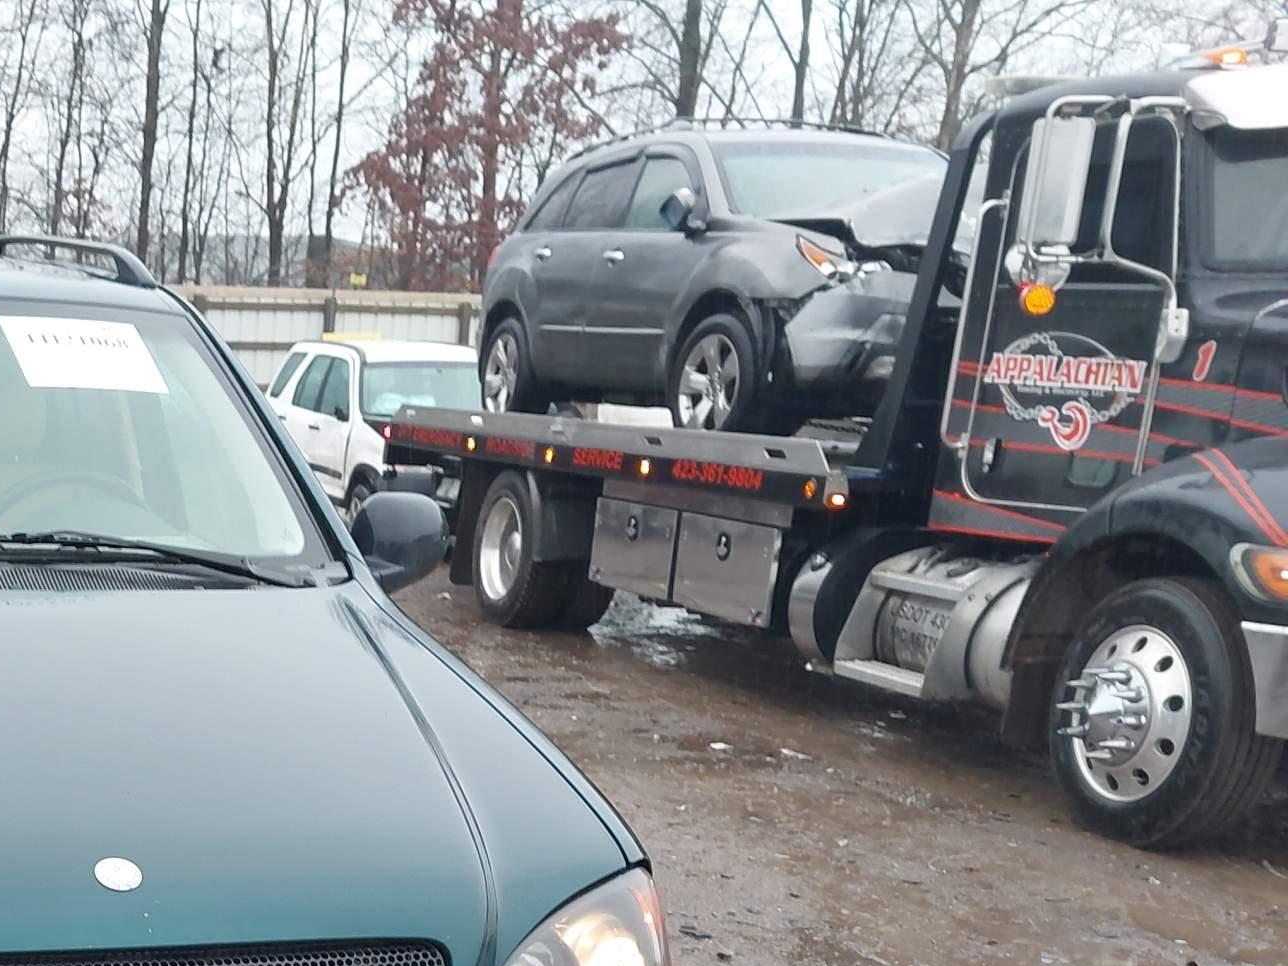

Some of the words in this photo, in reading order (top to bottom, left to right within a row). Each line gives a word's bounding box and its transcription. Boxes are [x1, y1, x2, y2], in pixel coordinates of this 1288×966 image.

[984, 352, 1148, 394] APPALACHIAN
[1193, 340, 1217, 382] 1
[572, 447, 624, 470] SERVICE
